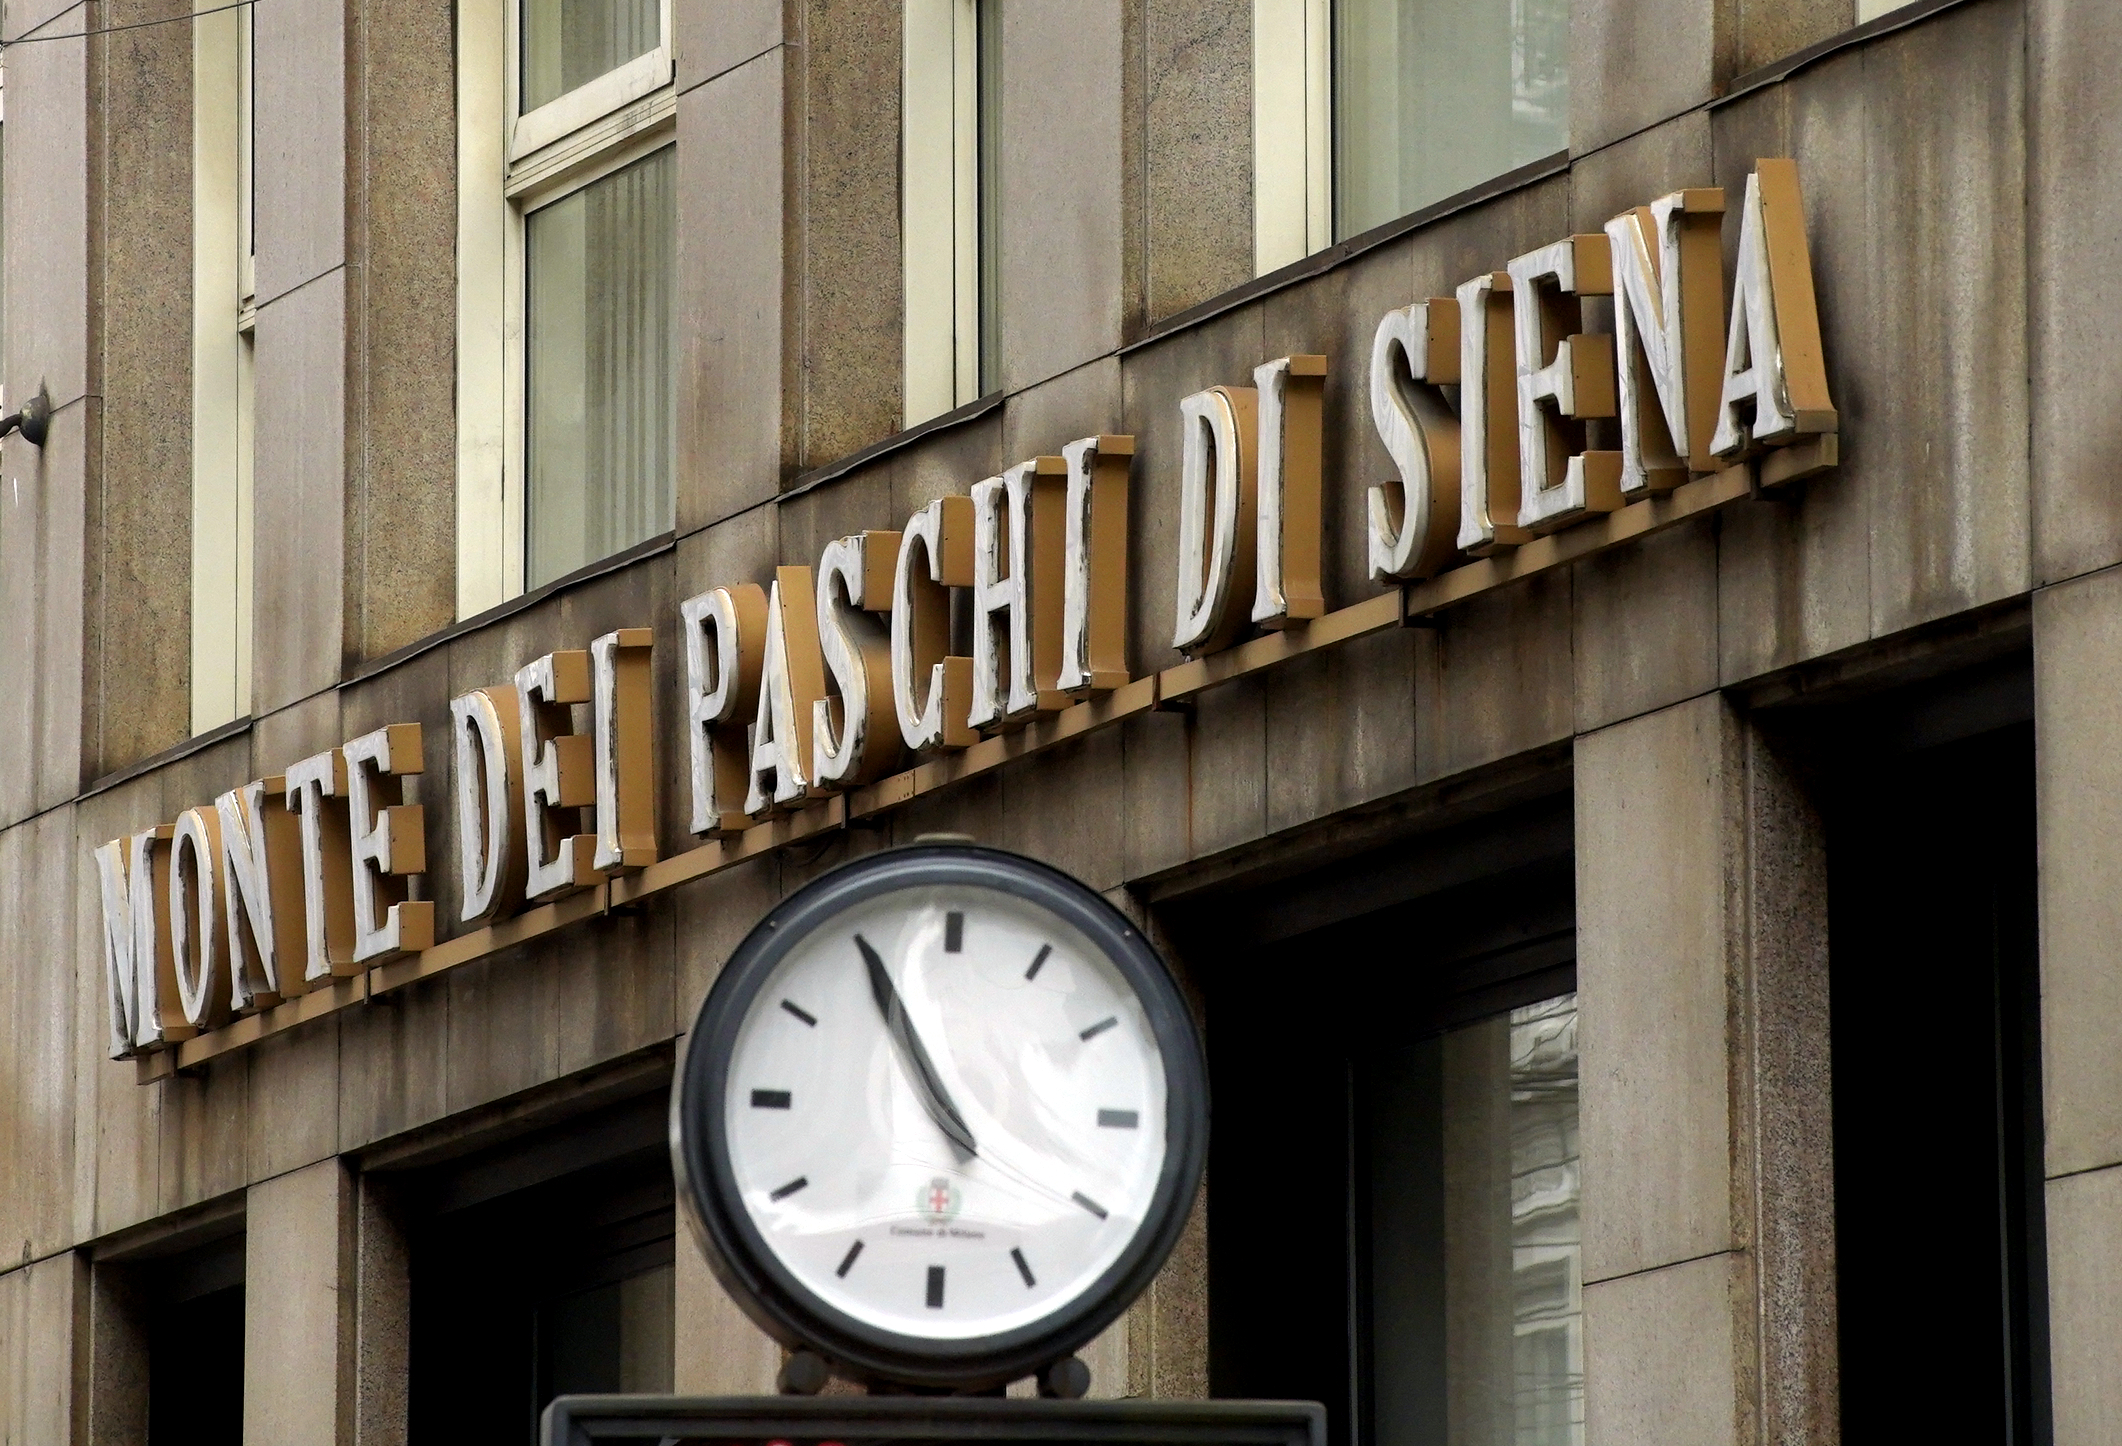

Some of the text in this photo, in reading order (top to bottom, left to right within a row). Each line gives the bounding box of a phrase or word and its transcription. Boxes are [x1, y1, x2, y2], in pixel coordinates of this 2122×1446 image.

[96, 158, 1838, 1060] MONTE DEI PASCHI DI SIENA
